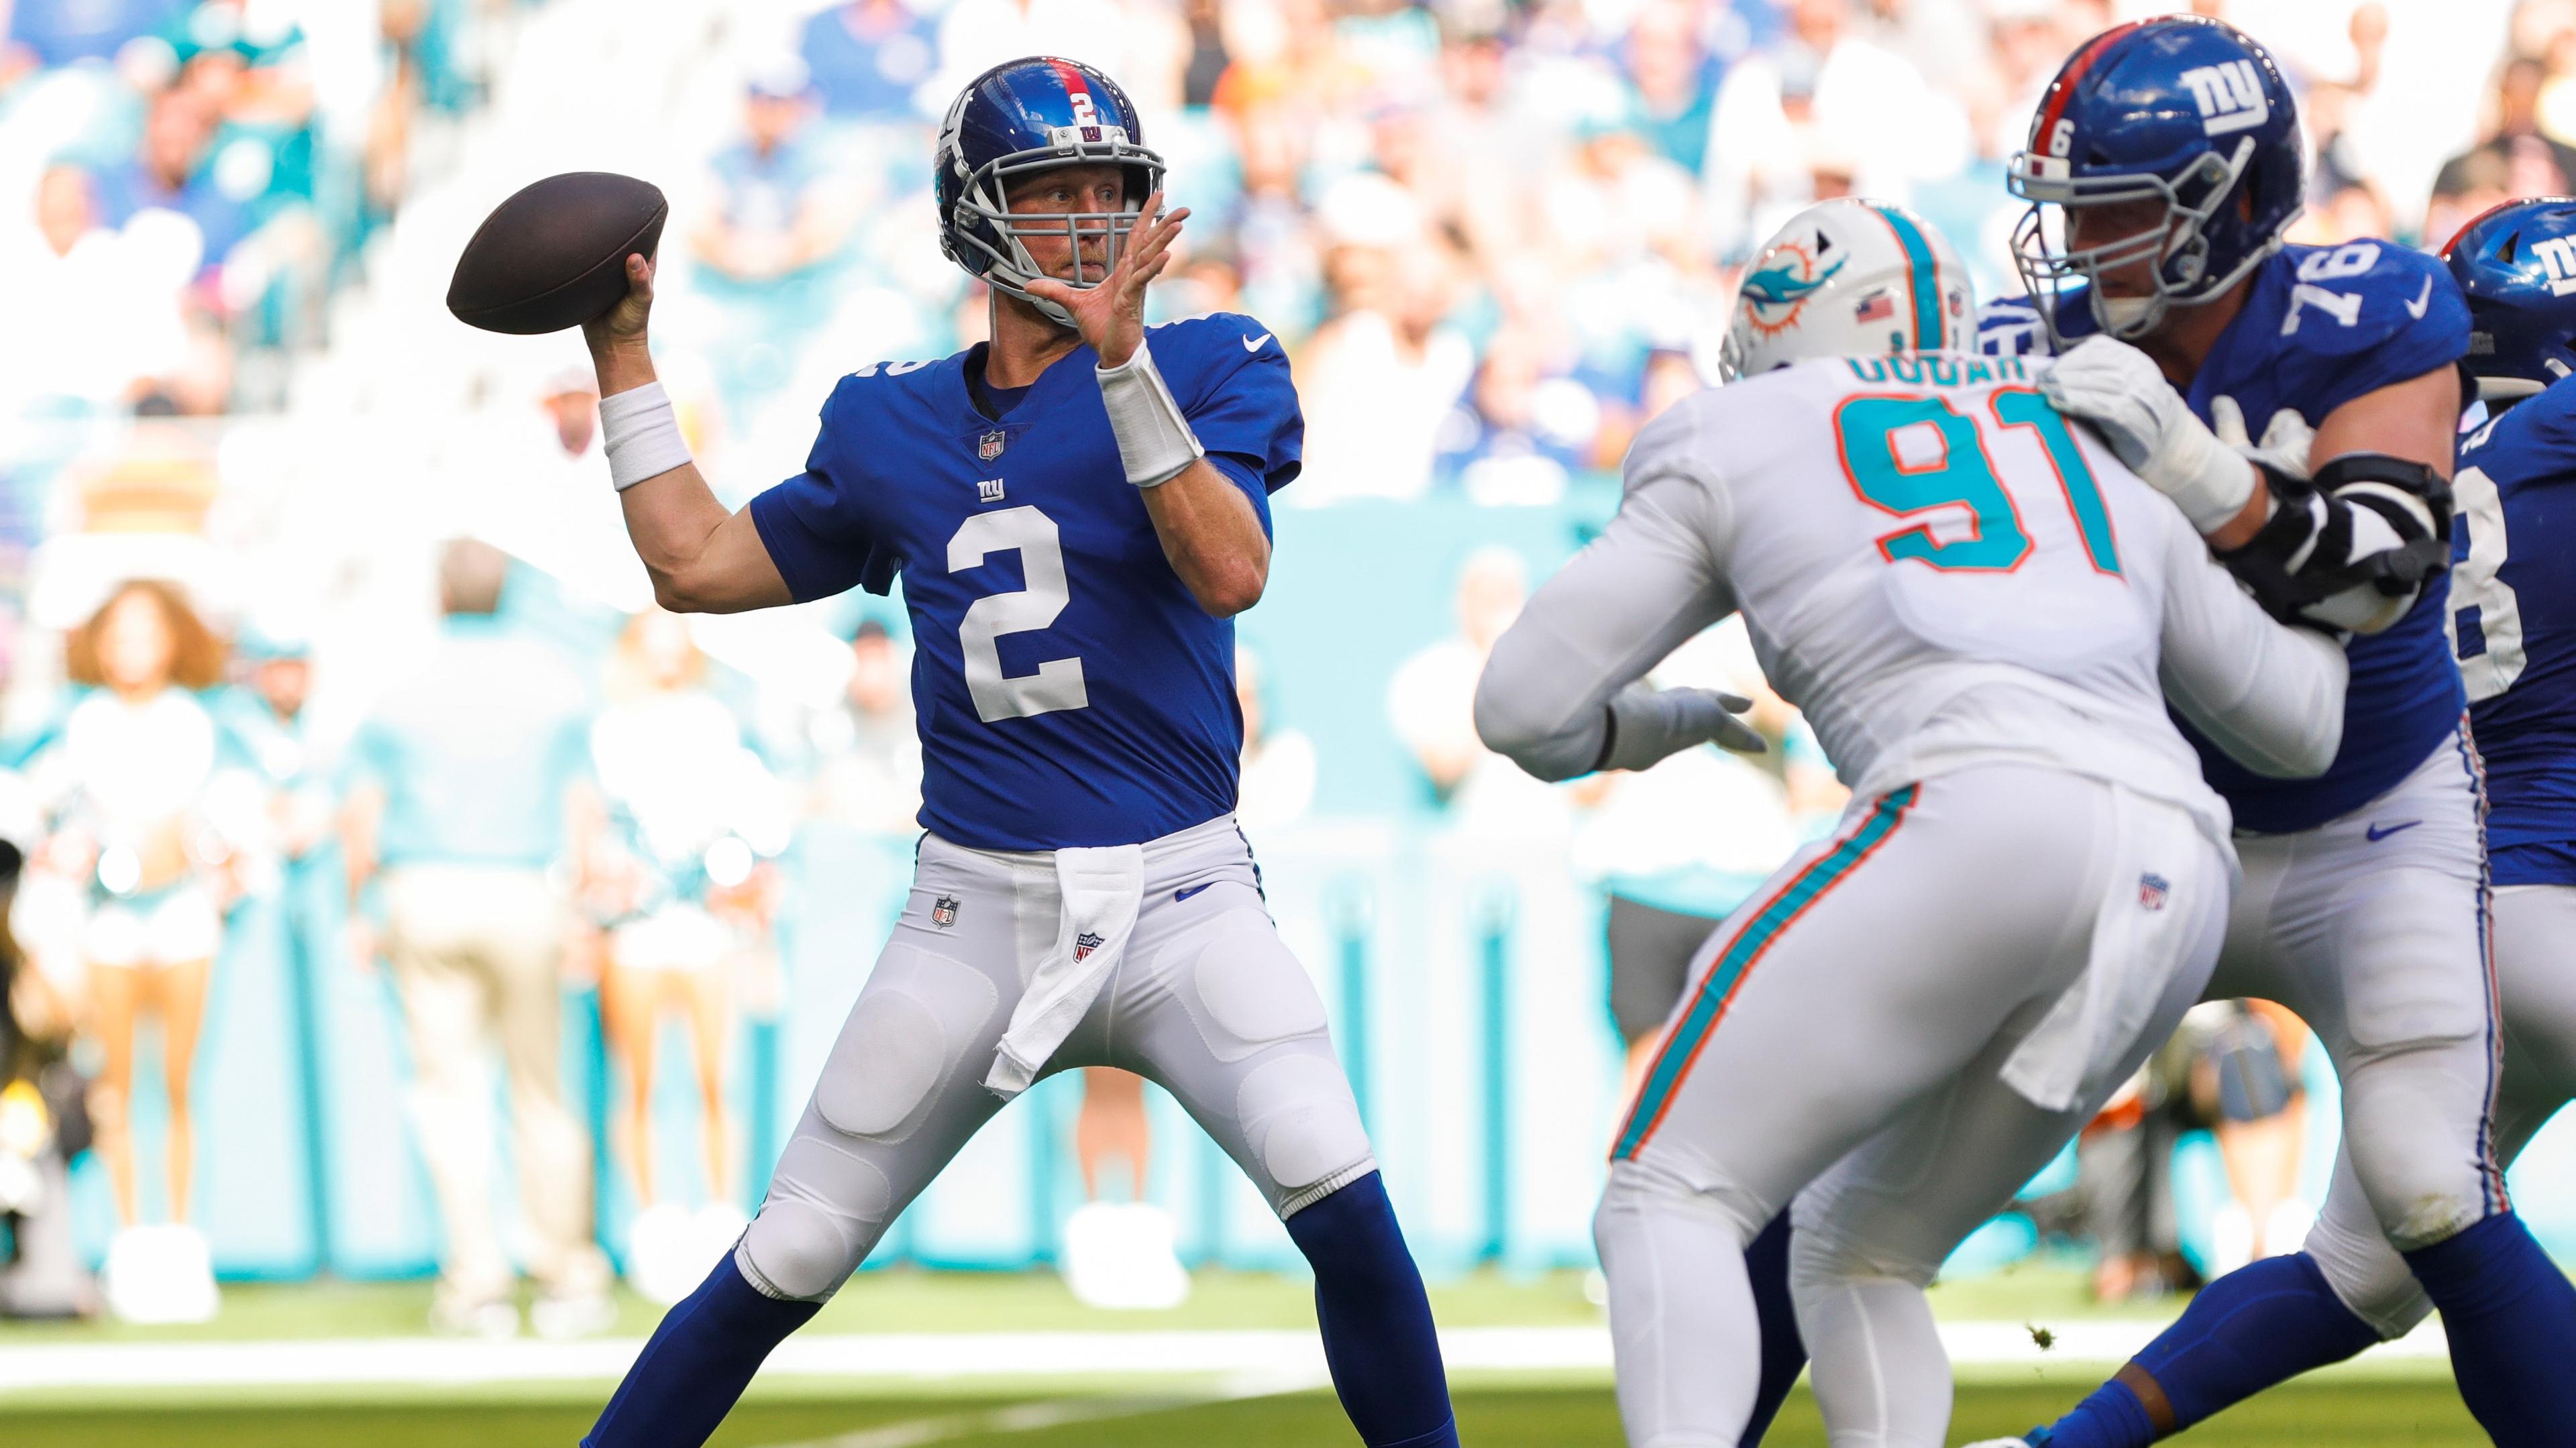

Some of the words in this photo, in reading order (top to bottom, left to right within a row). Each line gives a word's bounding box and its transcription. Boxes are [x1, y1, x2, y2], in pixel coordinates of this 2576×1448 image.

[1069, 93, 1098, 126] 2
[2176, 58, 2269, 137] ny
[2280, 243, 2381, 336] 76
[2530, 233, 2576, 297] n
[982, 443, 1000, 455] NFL
[977, 478, 1005, 503] ny
[1833, 385, 2125, 581] 91
[947, 505, 1089, 722] 2
[1075, 946, 1095, 962] NF
